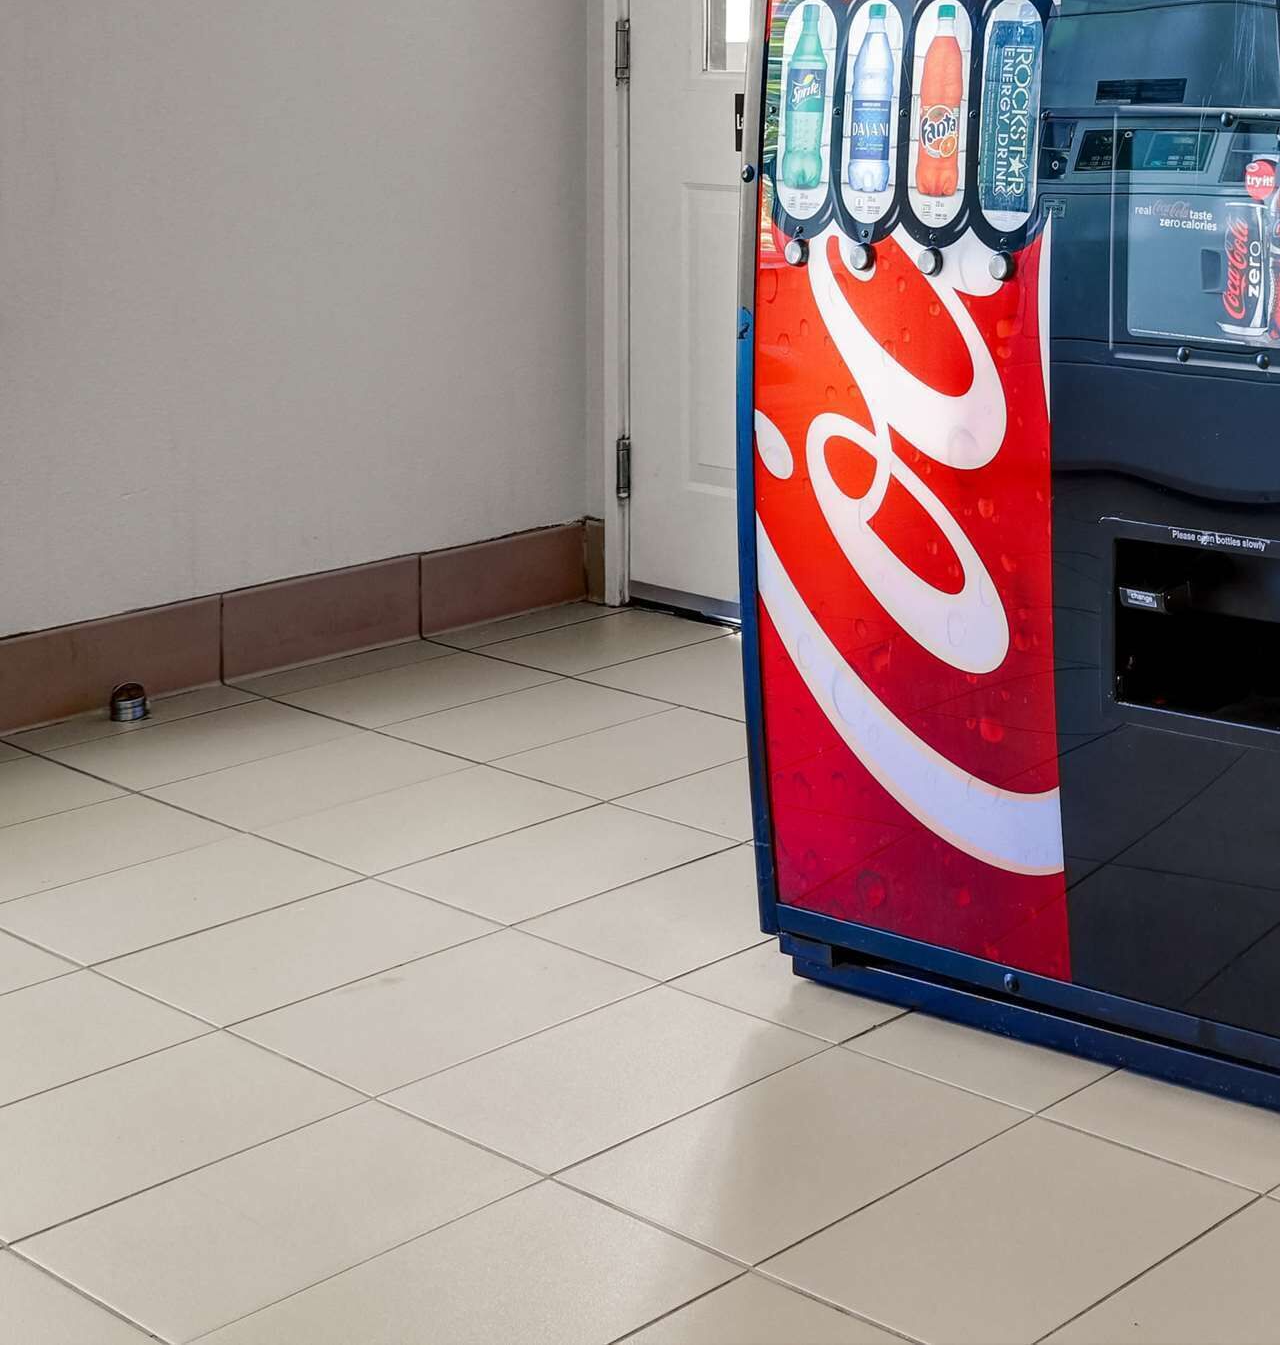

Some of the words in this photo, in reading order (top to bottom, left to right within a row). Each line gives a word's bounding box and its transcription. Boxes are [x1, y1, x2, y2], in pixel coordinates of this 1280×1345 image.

[792, 81, 821, 103] Sprite
[997, 46, 1016, 126] ENERGY
[853, 122, 889, 137] DASANI
[922, 117, 957, 141] Fanta
[994, 131, 1008, 196] DRINK
[1247, 175, 1262, 188] try
[1263, 174, 1274, 186] it!
[1135, 205, 1152, 216] real
[1190, 210, 1213, 221] taste
[1159, 218, 1180, 229] zero
[1181, 219, 1217, 231] calories
[1248, 241, 1262, 298] zero
[1172, 530, 1196, 543] Please
[1216, 533, 1240, 548] bottles
[1242, 539, 1266, 552] slowly
[1130, 592, 1153, 603] change
